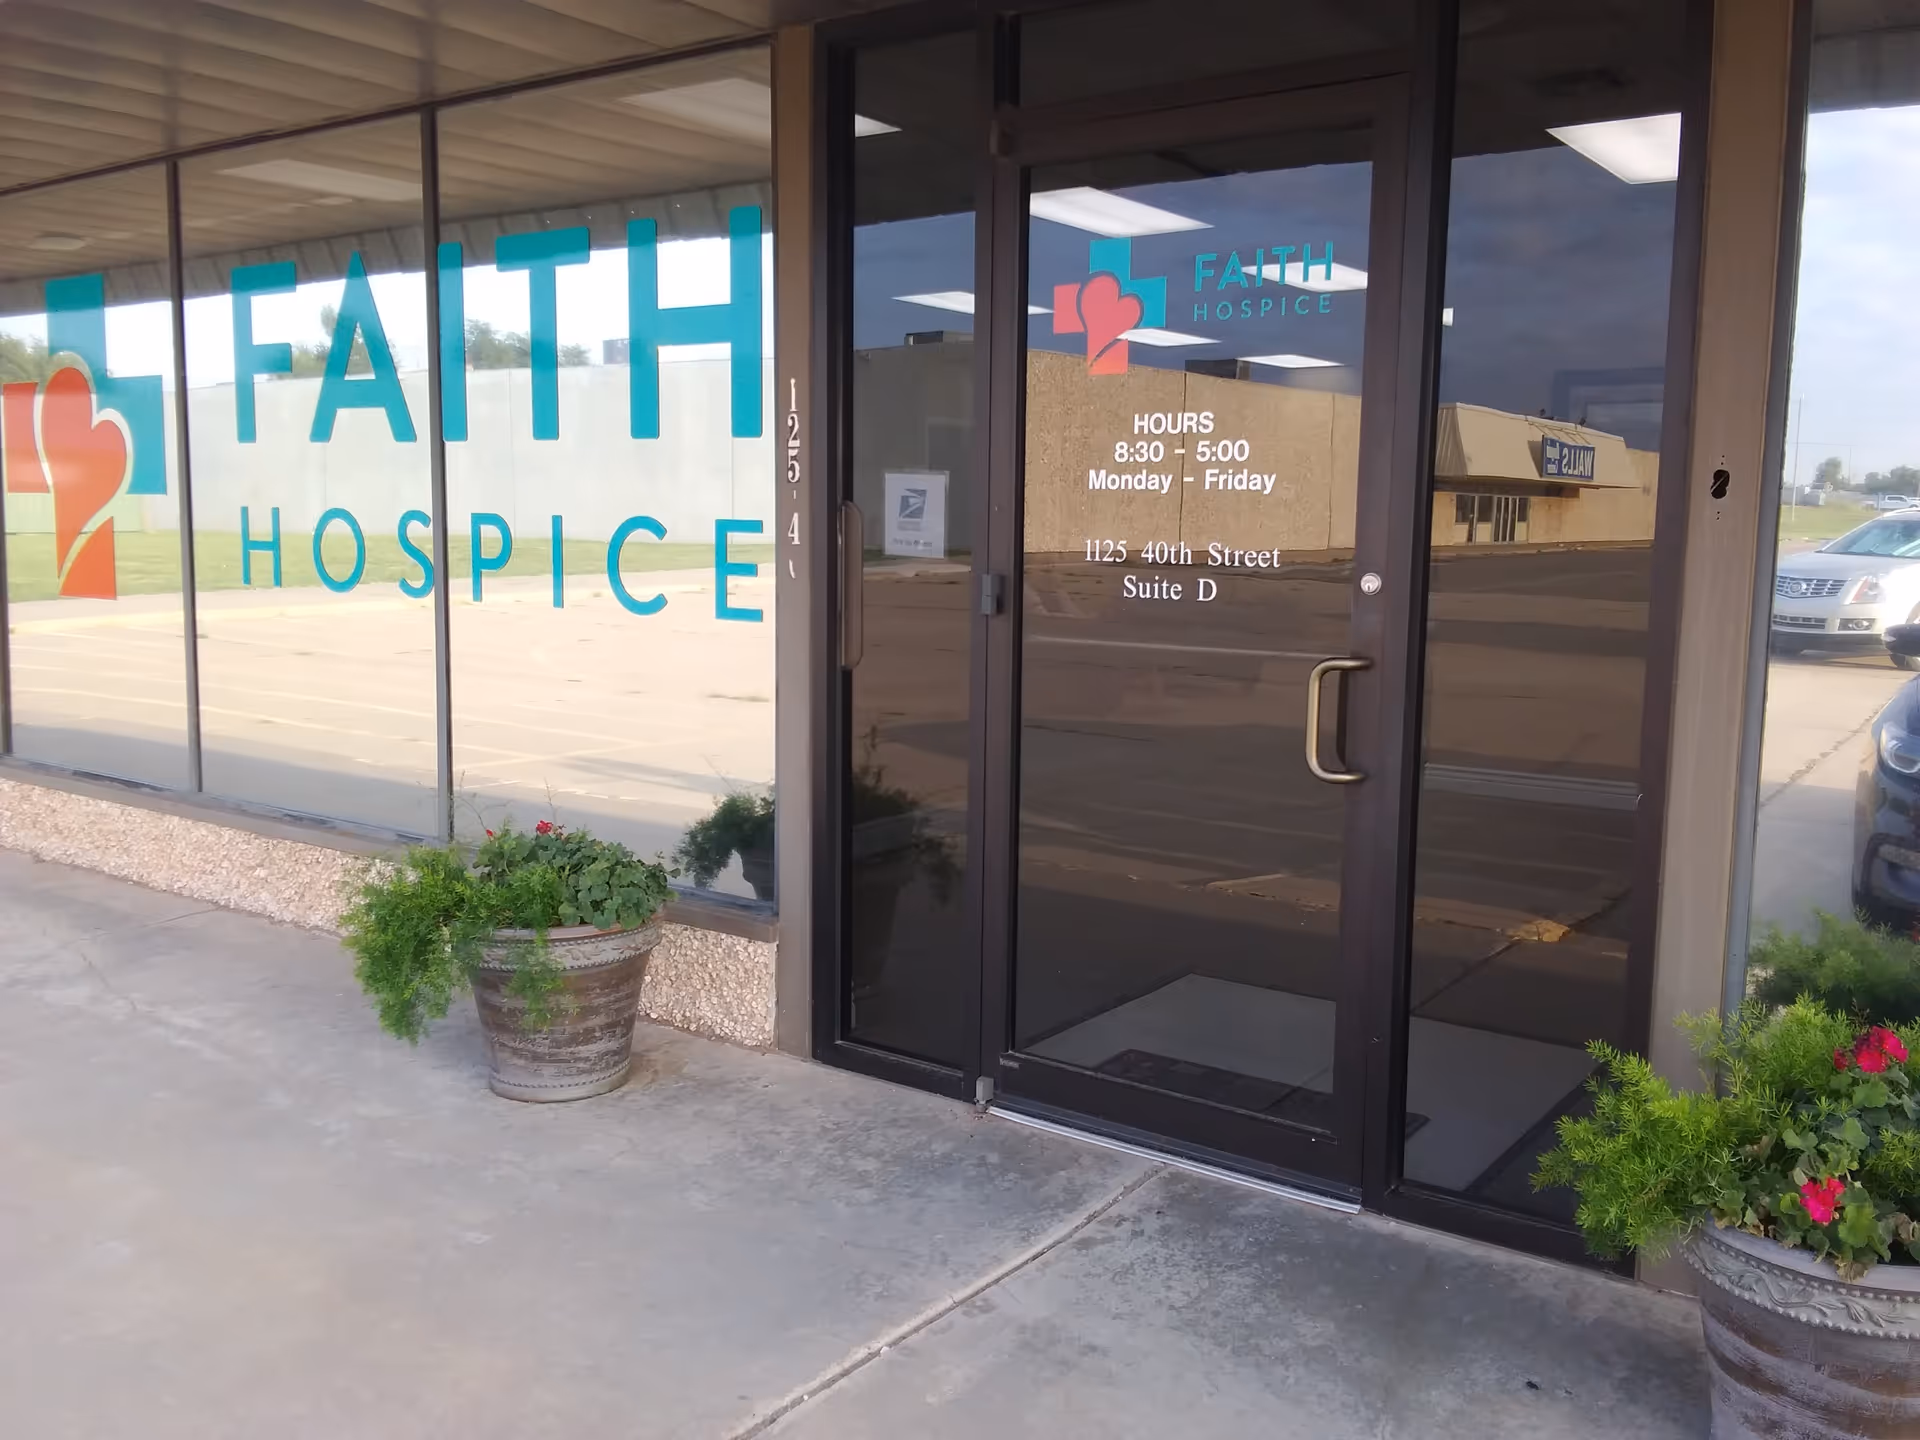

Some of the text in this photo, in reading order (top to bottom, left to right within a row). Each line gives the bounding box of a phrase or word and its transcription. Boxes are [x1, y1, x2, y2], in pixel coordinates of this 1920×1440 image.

[1193, 241, 1334, 292] FAITH
[1193, 294, 1331, 321] HOSPICE
[231, 205, 763, 443] FAITH
[1133, 411, 1214, 434] HOURS
[1114, 440, 1164, 462] 8:30
[1196, 439, 1250, 462] 5:00
[1088, 469, 1173, 494] Monday
[1204, 468, 1277, 495] Friday
[240, 506, 763, 623] HOSPICE
[1085, 539, 1281, 568] 1125 40th Street
[1123, 575, 1217, 601] Suite D
